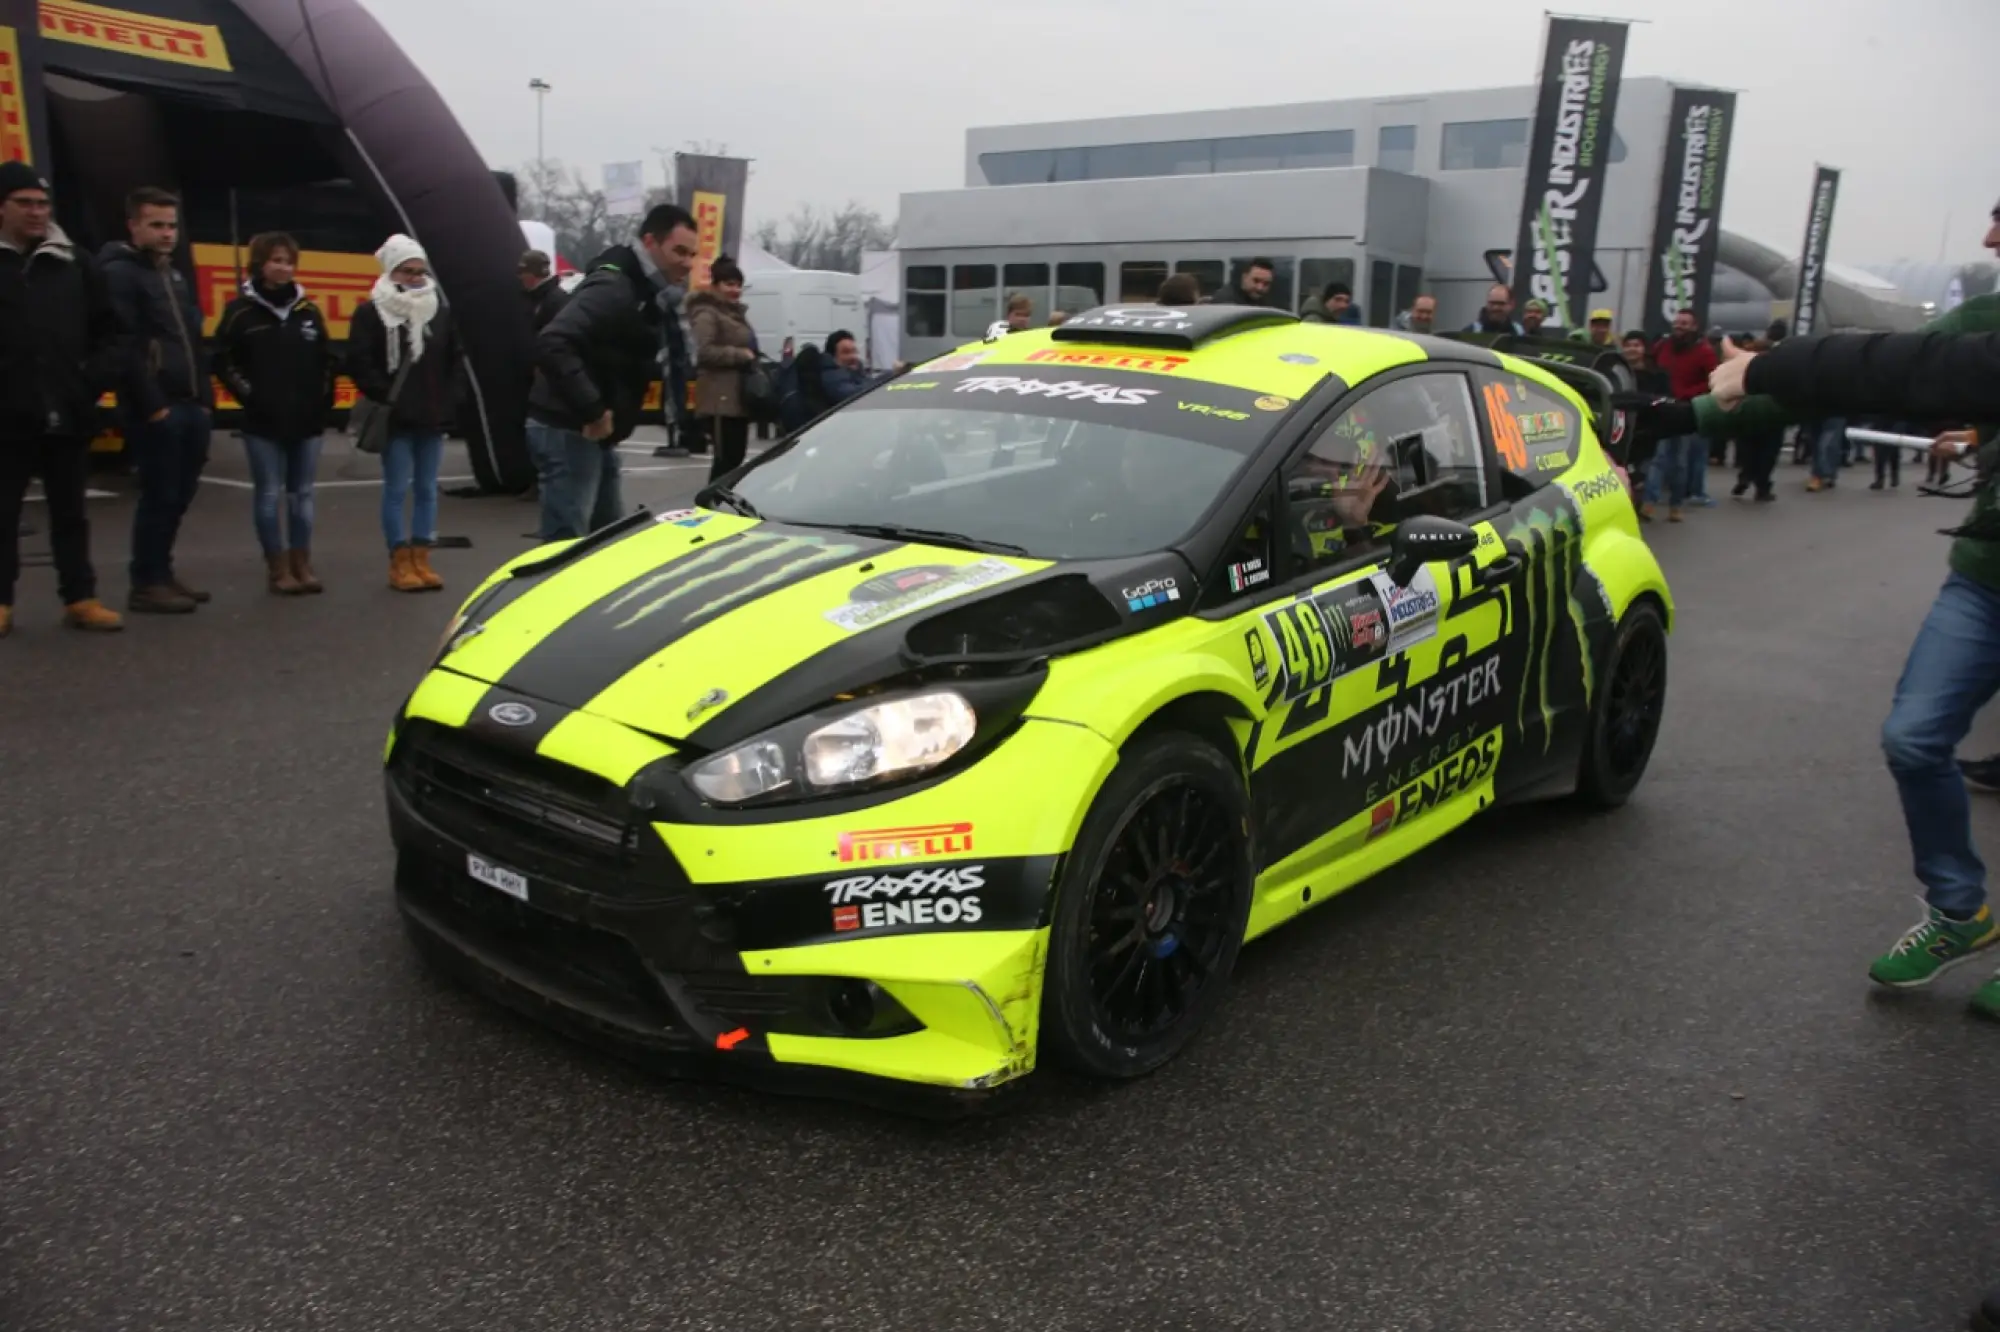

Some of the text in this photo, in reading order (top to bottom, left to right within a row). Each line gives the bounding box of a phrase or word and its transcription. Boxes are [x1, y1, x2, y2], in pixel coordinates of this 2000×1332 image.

[1548, 39, 1594, 184] INDUSTRIES
[1580, 43, 1610, 168] BIOGAS ENERGY
[1661, 218, 1710, 324] ASER
[953, 376, 1162, 405] TRAXXAS
[1024, 349, 1190, 372] PIRELLI
[1483, 383, 1527, 472] 46
[1408, 533, 1462, 541] OAKLEY
[1122, 577, 1176, 599] GoPro
[1276, 602, 1330, 690] 46
[1366, 722, 1478, 803] ENERGY
[1397, 733, 1497, 820] ENEOS
[839, 822, 973, 862] PIRELLI
[823, 865, 986, 904] TRAXXAS
[862, 896, 982, 928] ENEOS
